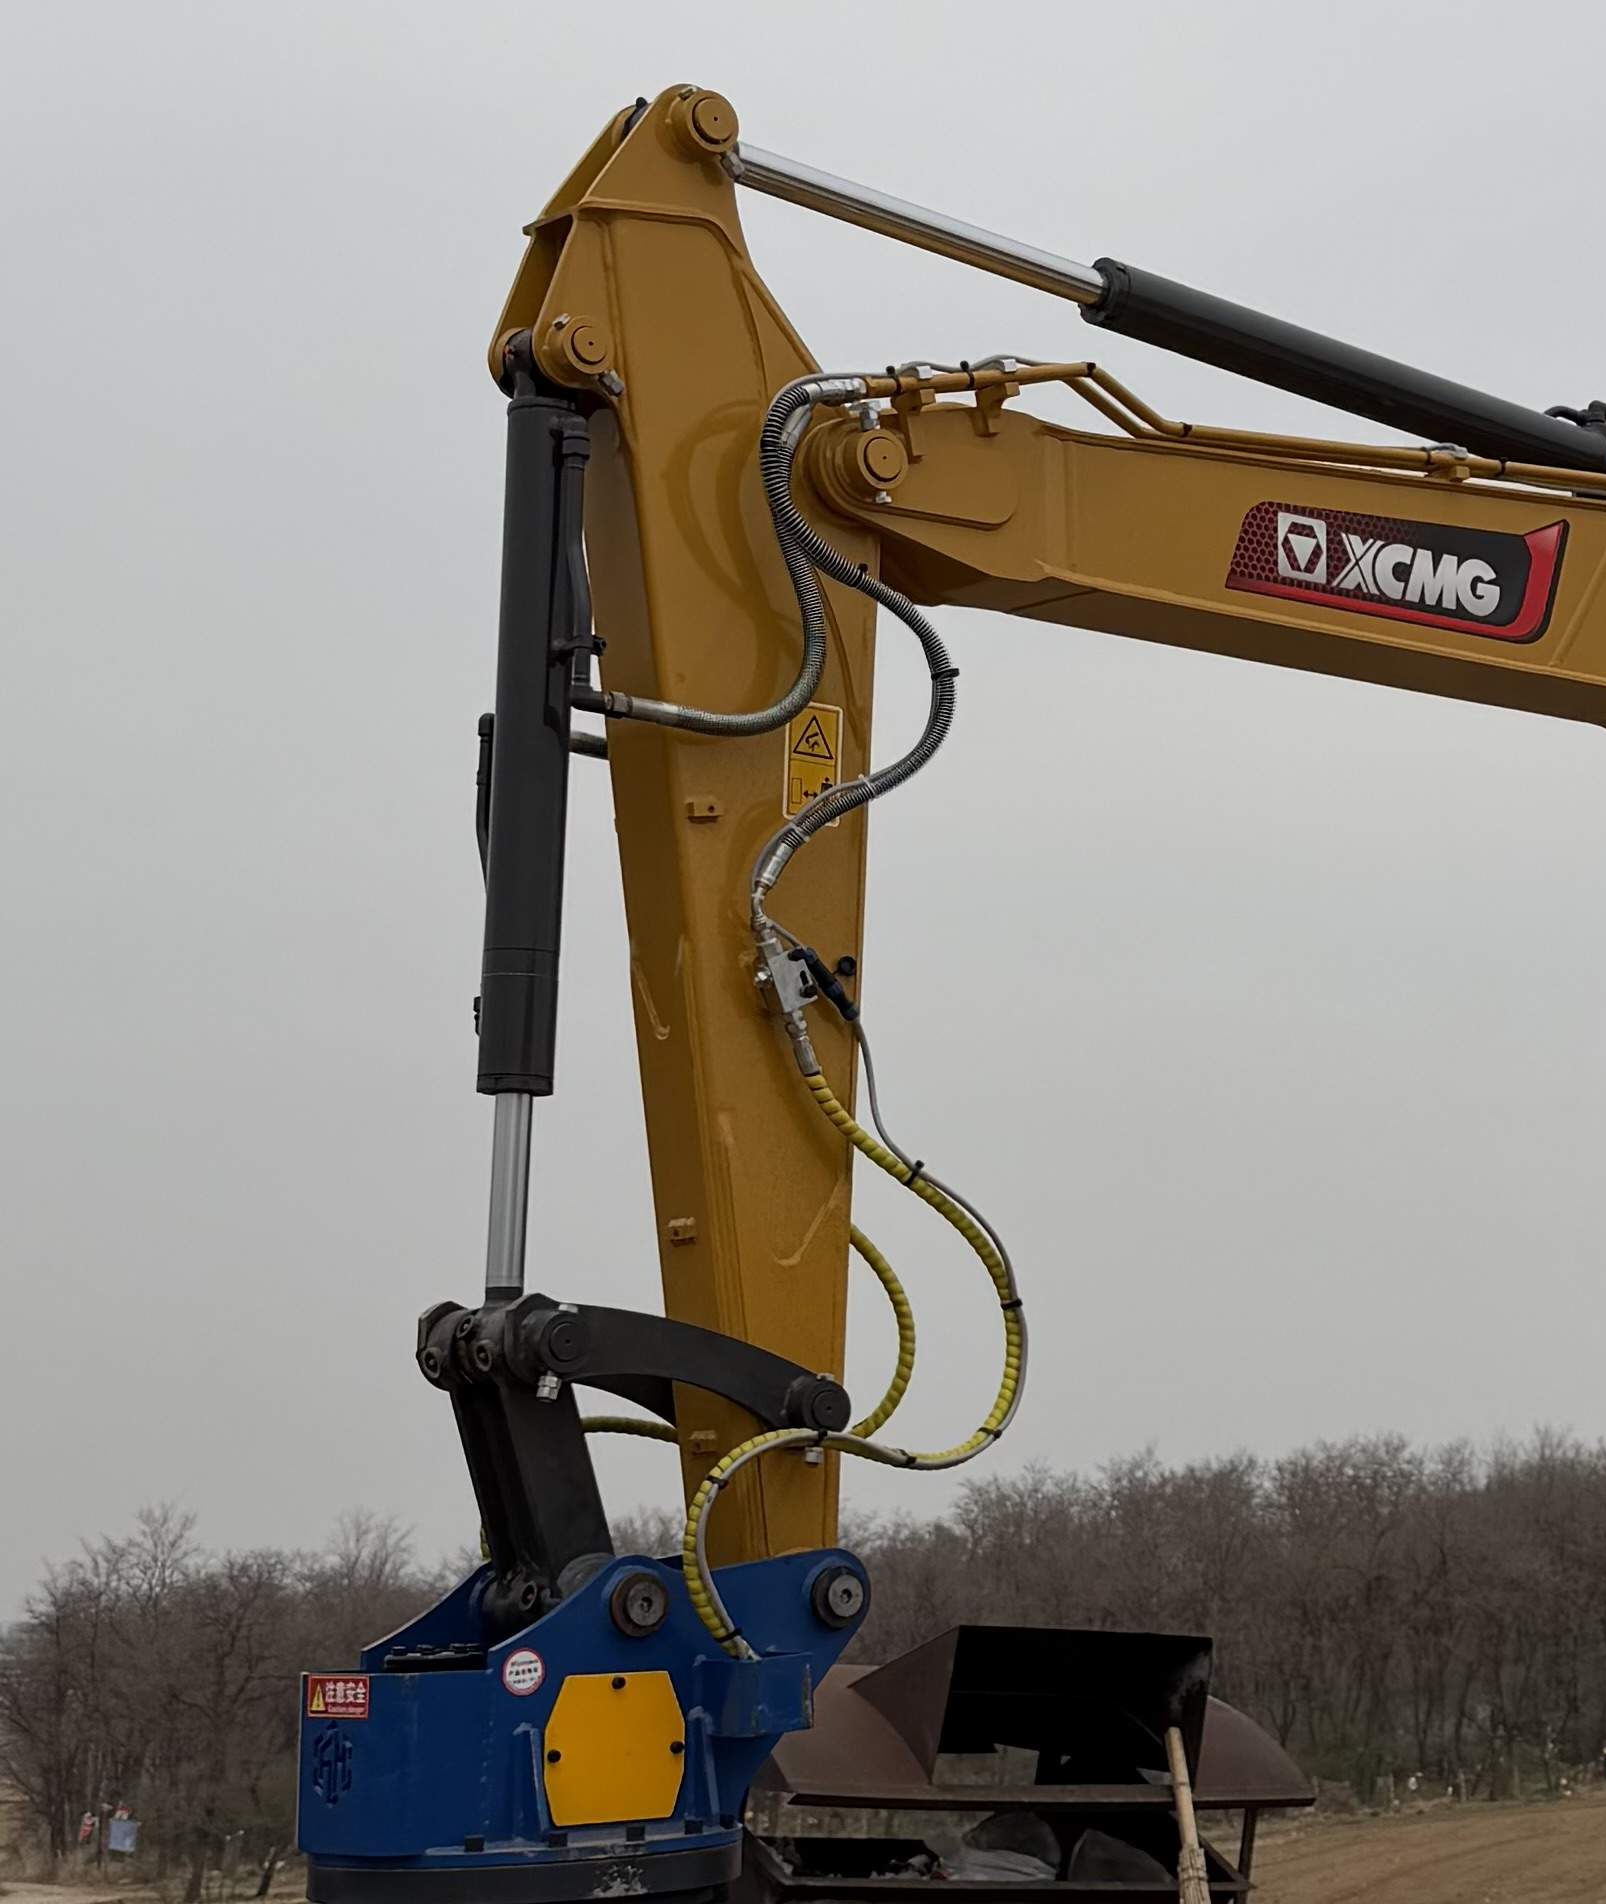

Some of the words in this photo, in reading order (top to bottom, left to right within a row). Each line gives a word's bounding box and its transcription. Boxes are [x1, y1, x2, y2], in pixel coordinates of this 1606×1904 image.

[1331, 531, 1501, 617] XCMG
[324, 1680, 367, 1704] 注意安全
